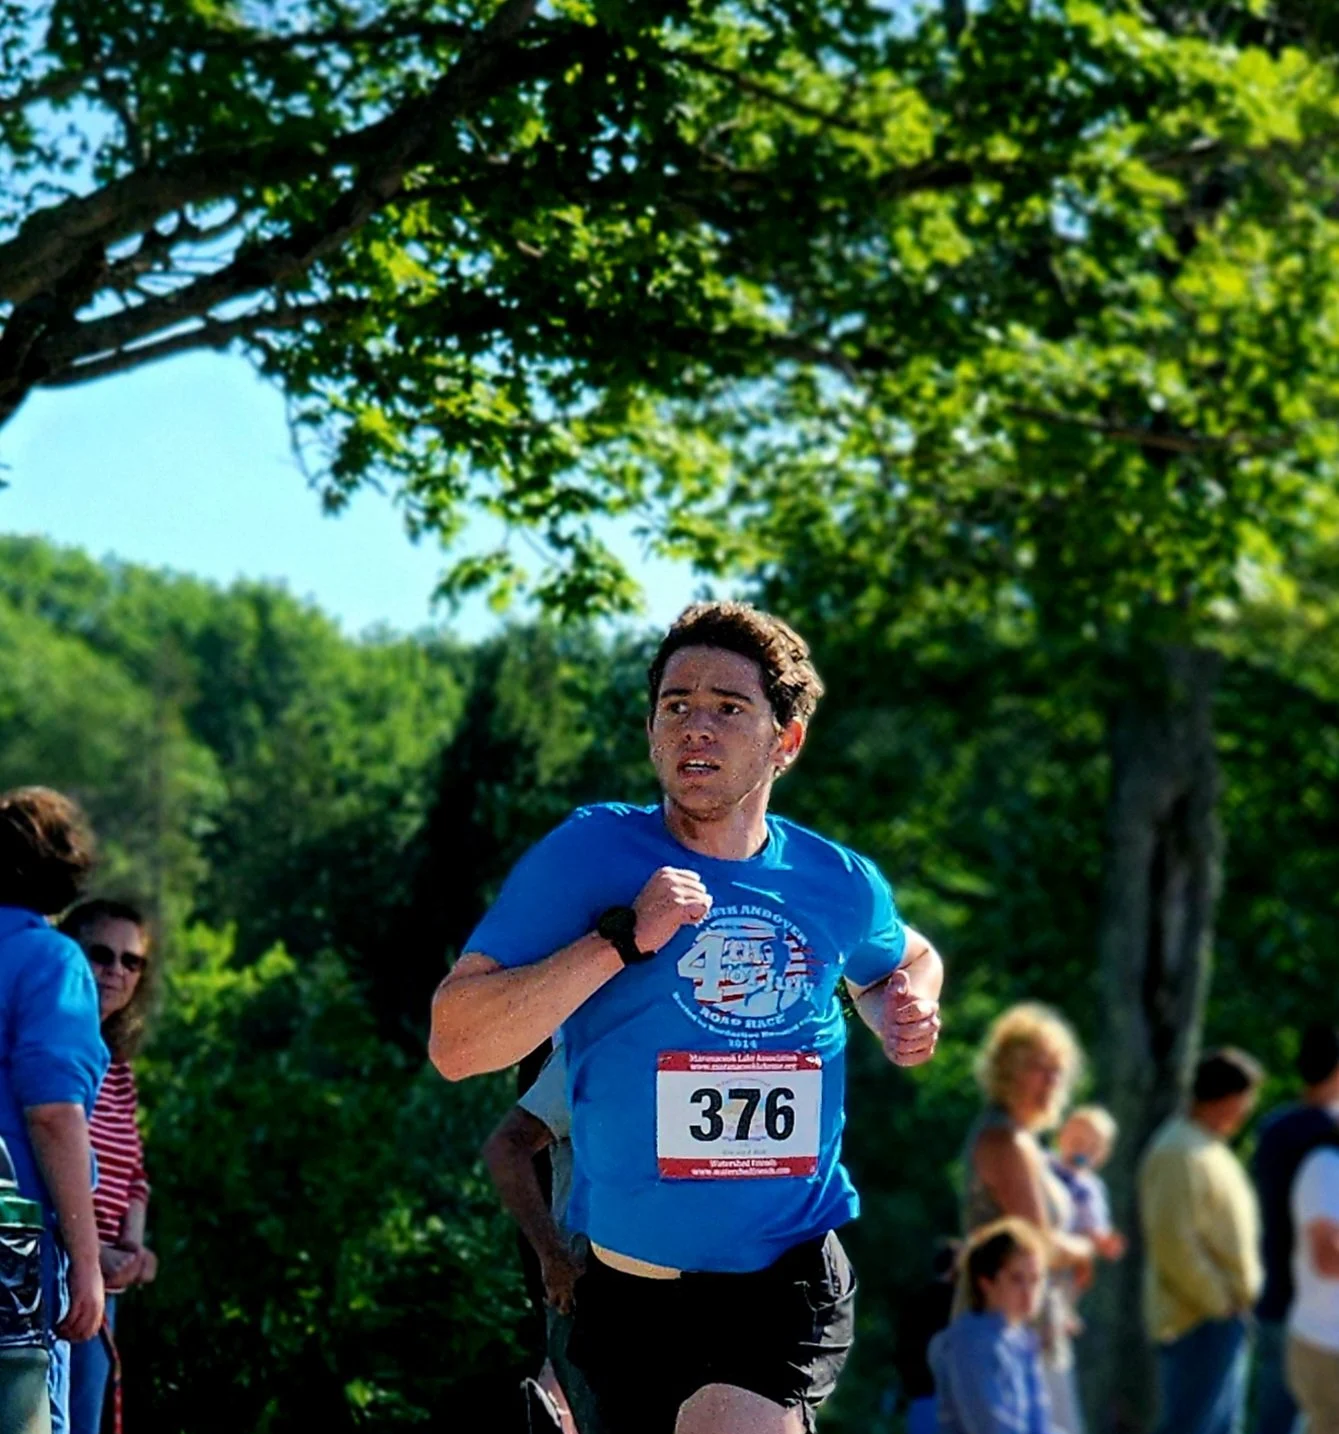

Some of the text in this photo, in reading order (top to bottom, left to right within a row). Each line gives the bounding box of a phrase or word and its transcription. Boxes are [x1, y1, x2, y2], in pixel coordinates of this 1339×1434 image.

[695, 905, 808, 945] ORTH ANDOVER
[700, 1006, 742, 1026] ROAD
[745, 1013, 785, 1029] RACE
[738, 1054, 755, 1062] Lake
[756, 1053, 798, 1062] Association
[689, 1087, 795, 1142] 376
[709, 1158, 777, 1168] Watershed Friends
